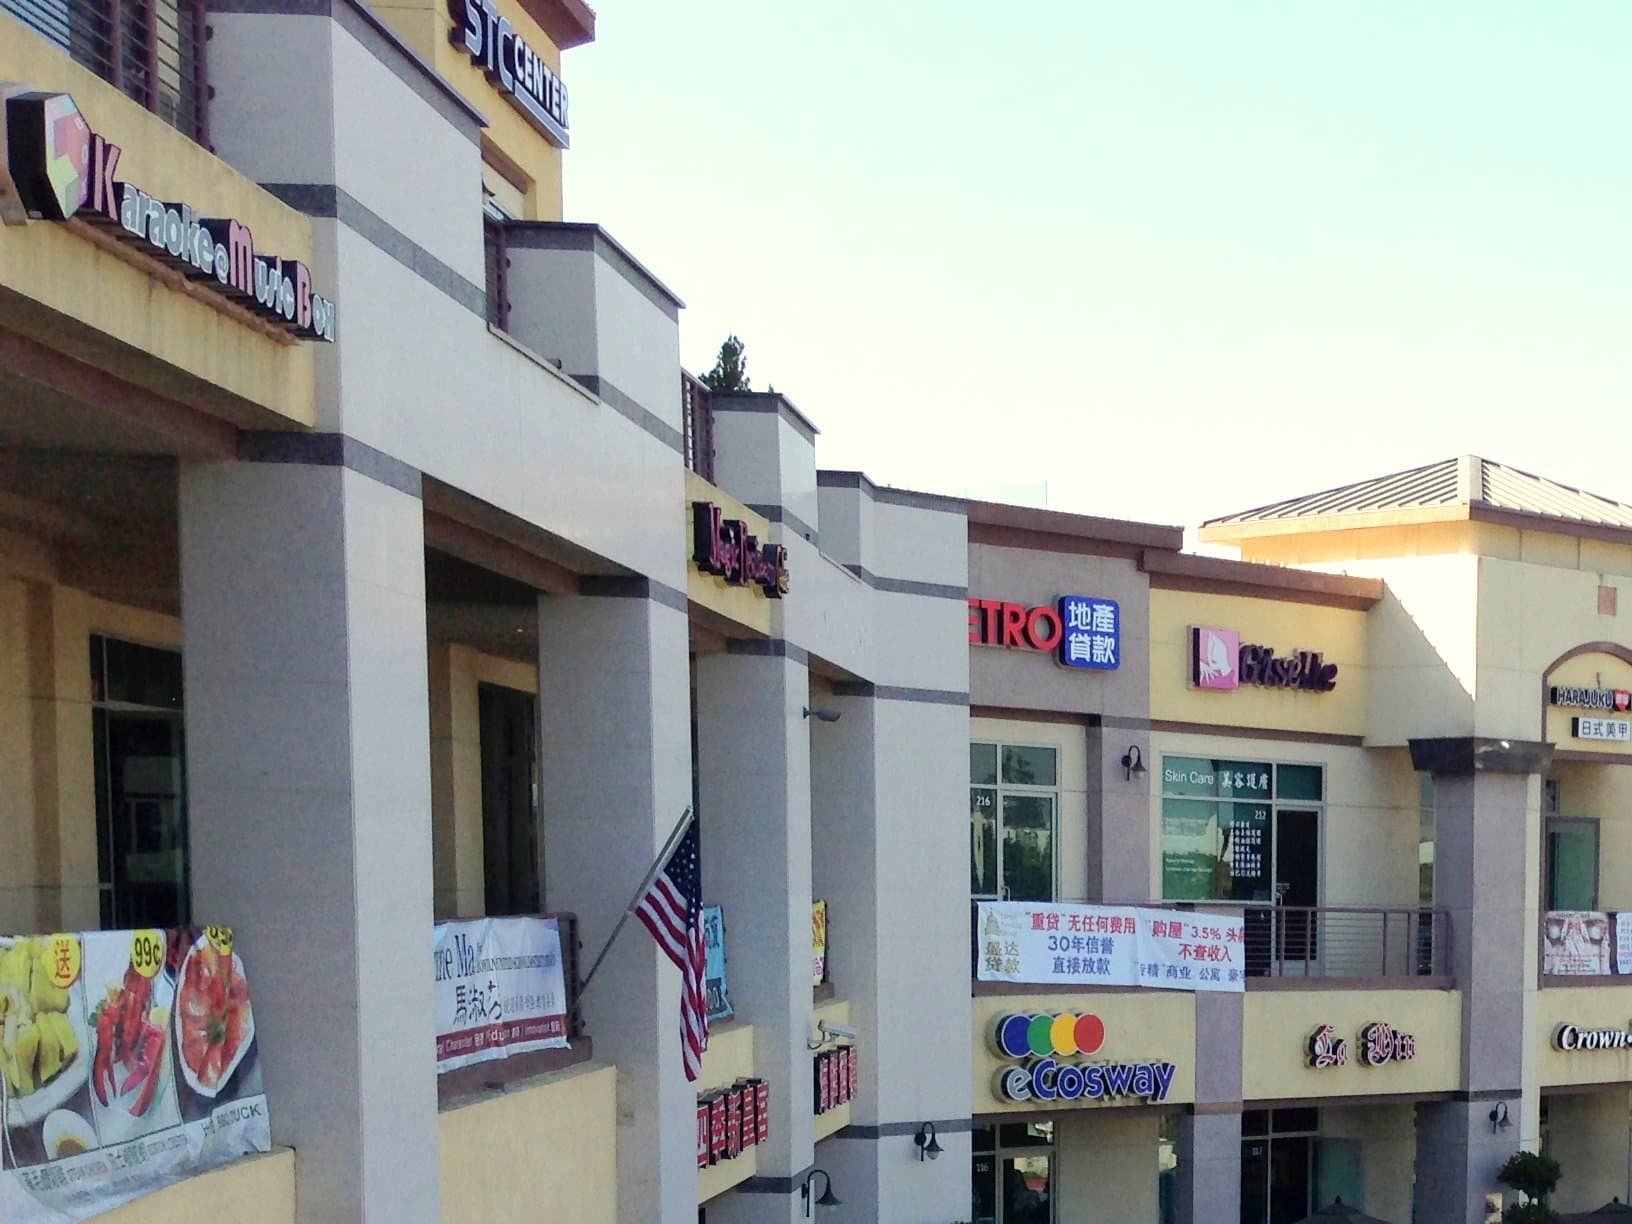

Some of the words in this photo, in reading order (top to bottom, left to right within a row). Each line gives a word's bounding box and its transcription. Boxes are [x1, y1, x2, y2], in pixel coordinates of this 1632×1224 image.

[464, 0, 513, 92] STC
[514, 34, 569, 130] CENTER
[1068, 601, 1116, 633] 地產
[1068, 633, 1117, 666] 貸款
[1556, 687, 1614, 709] HARAJUKU
[1582, 721, 1628, 738] 日式美甲
[1165, 768, 1188, 783] Skin
[1189, 770, 1215, 786] Care
[976, 796, 991, 806] 216
[53, 938, 72, 980] 送
[1178, 943, 1232, 963] 不查收入
[1006, 1058, 1176, 1103] eCosway
